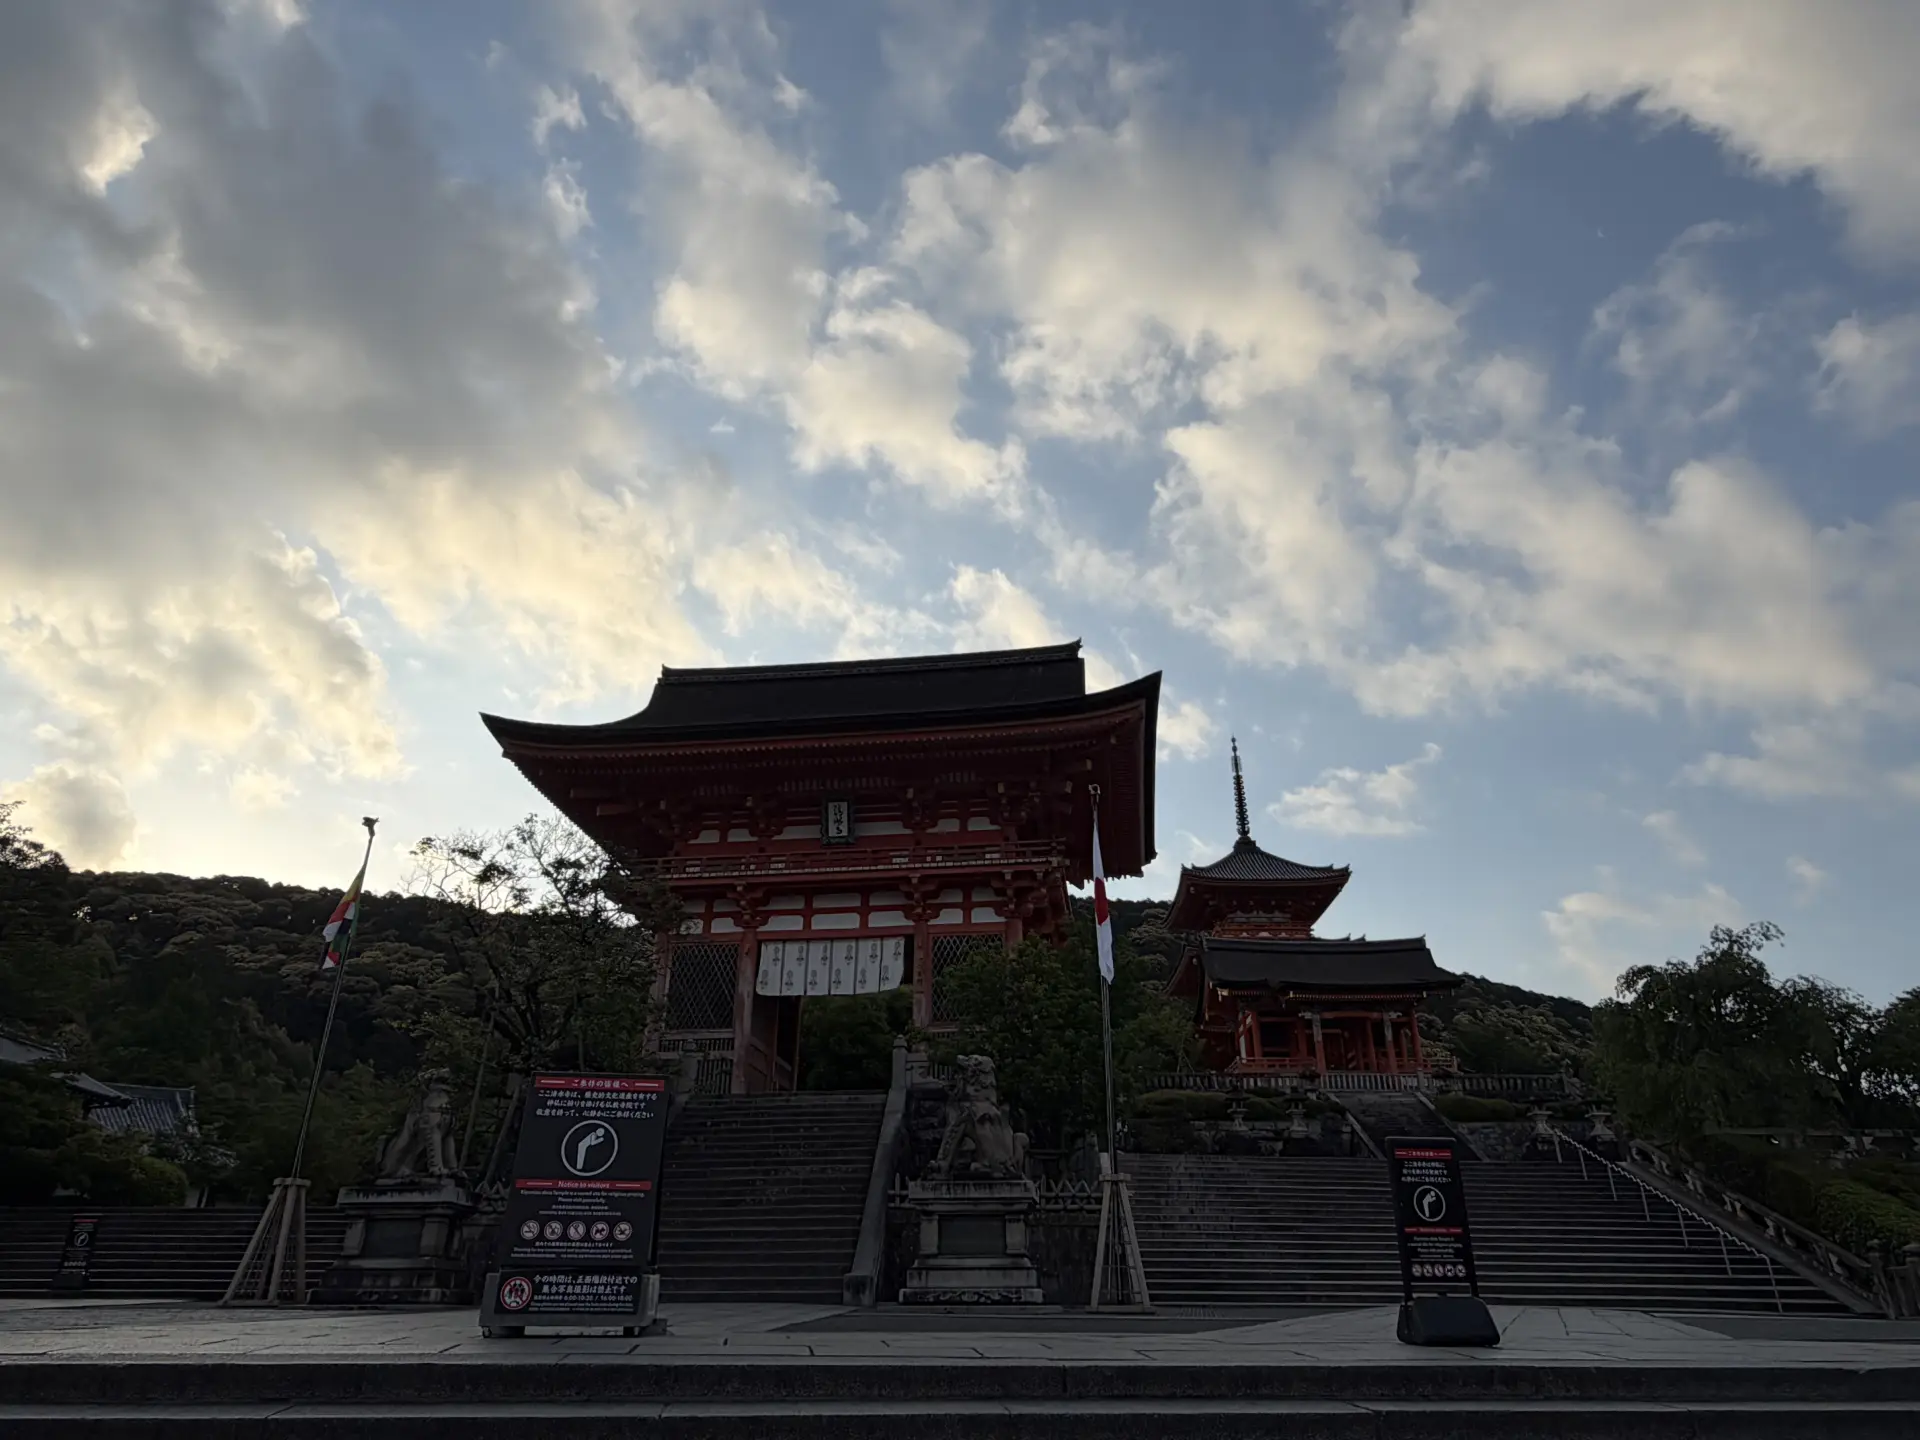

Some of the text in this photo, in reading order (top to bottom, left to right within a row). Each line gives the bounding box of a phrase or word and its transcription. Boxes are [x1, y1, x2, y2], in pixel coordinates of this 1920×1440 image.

[572, 1079, 629, 1089] ご参拝の皆様へ
[558, 1180, 579, 1188] Notice
